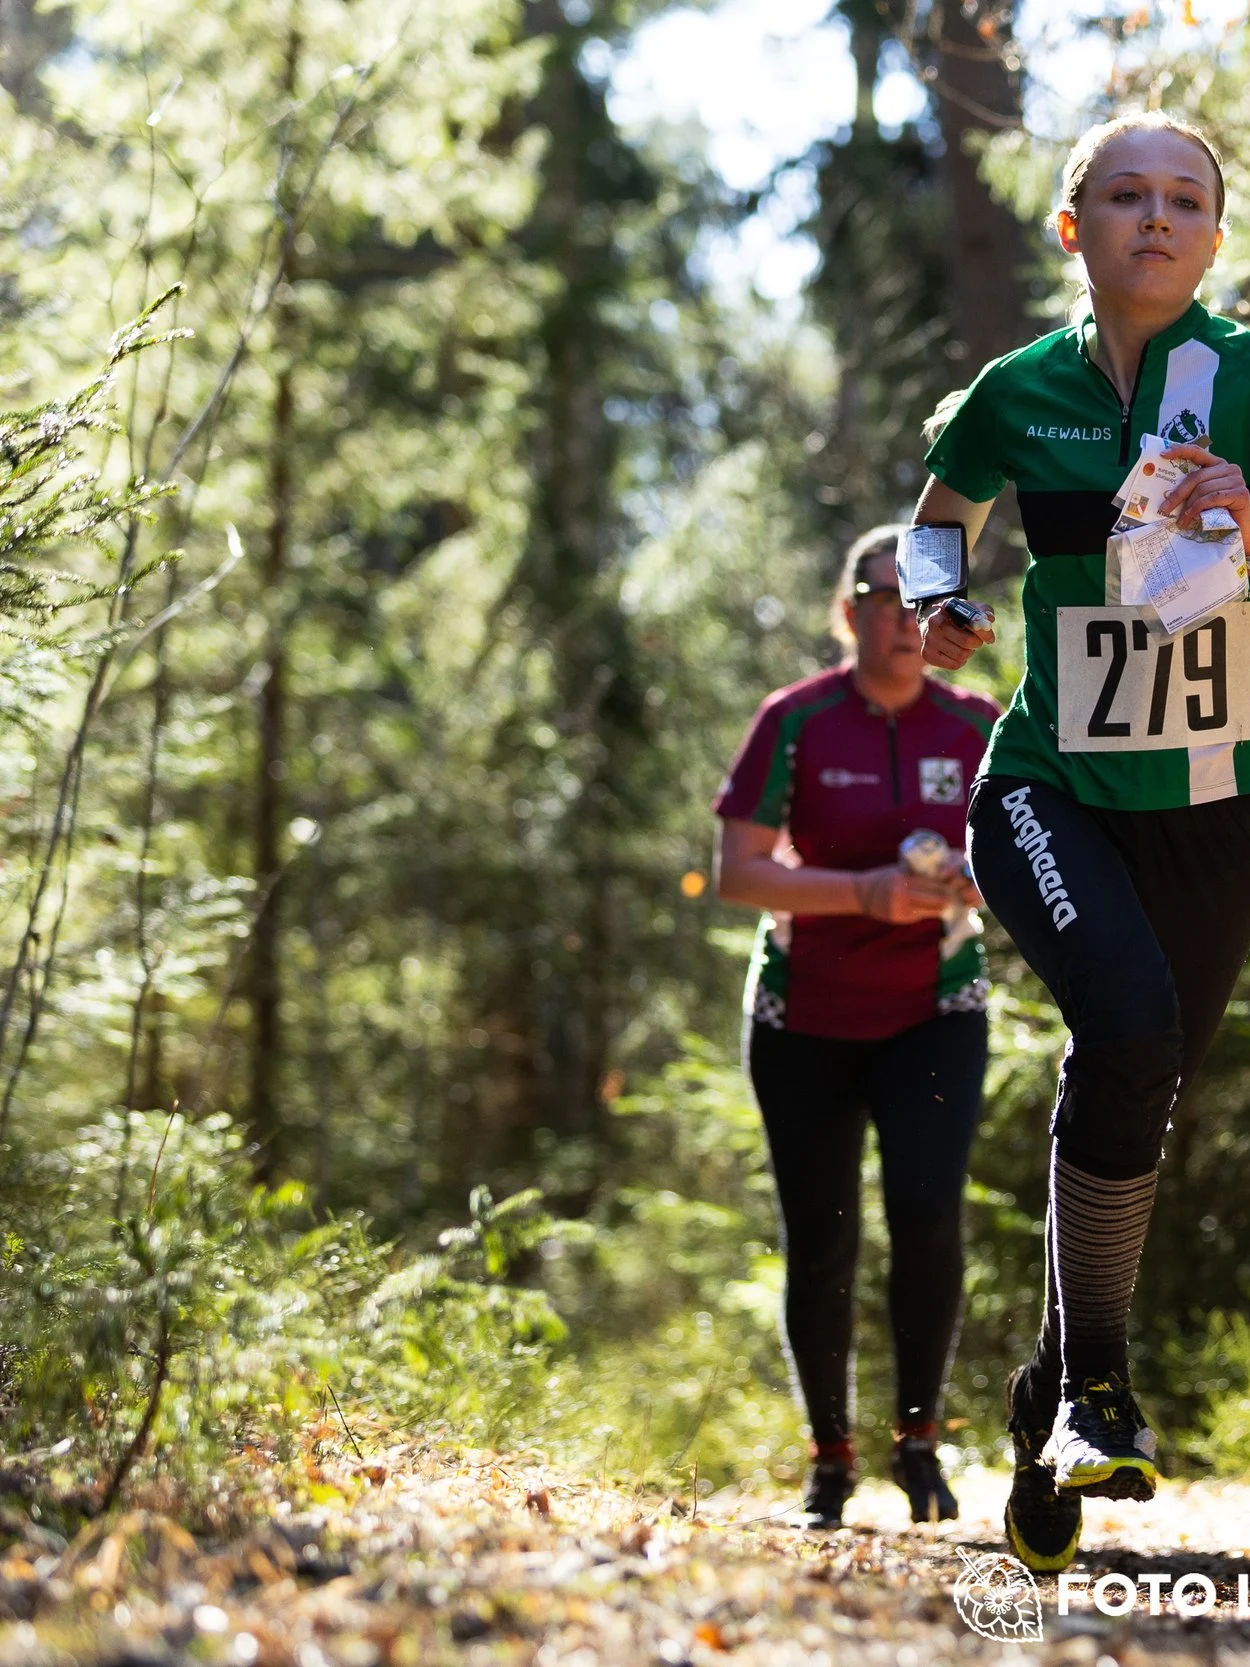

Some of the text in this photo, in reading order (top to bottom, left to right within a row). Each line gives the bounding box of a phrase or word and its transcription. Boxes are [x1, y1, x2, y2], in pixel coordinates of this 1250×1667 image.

[1026, 425, 1112, 441] ALEWALDS
[1086, 616, 1228, 738] 279
[1001, 785, 1078, 932] bagheera
